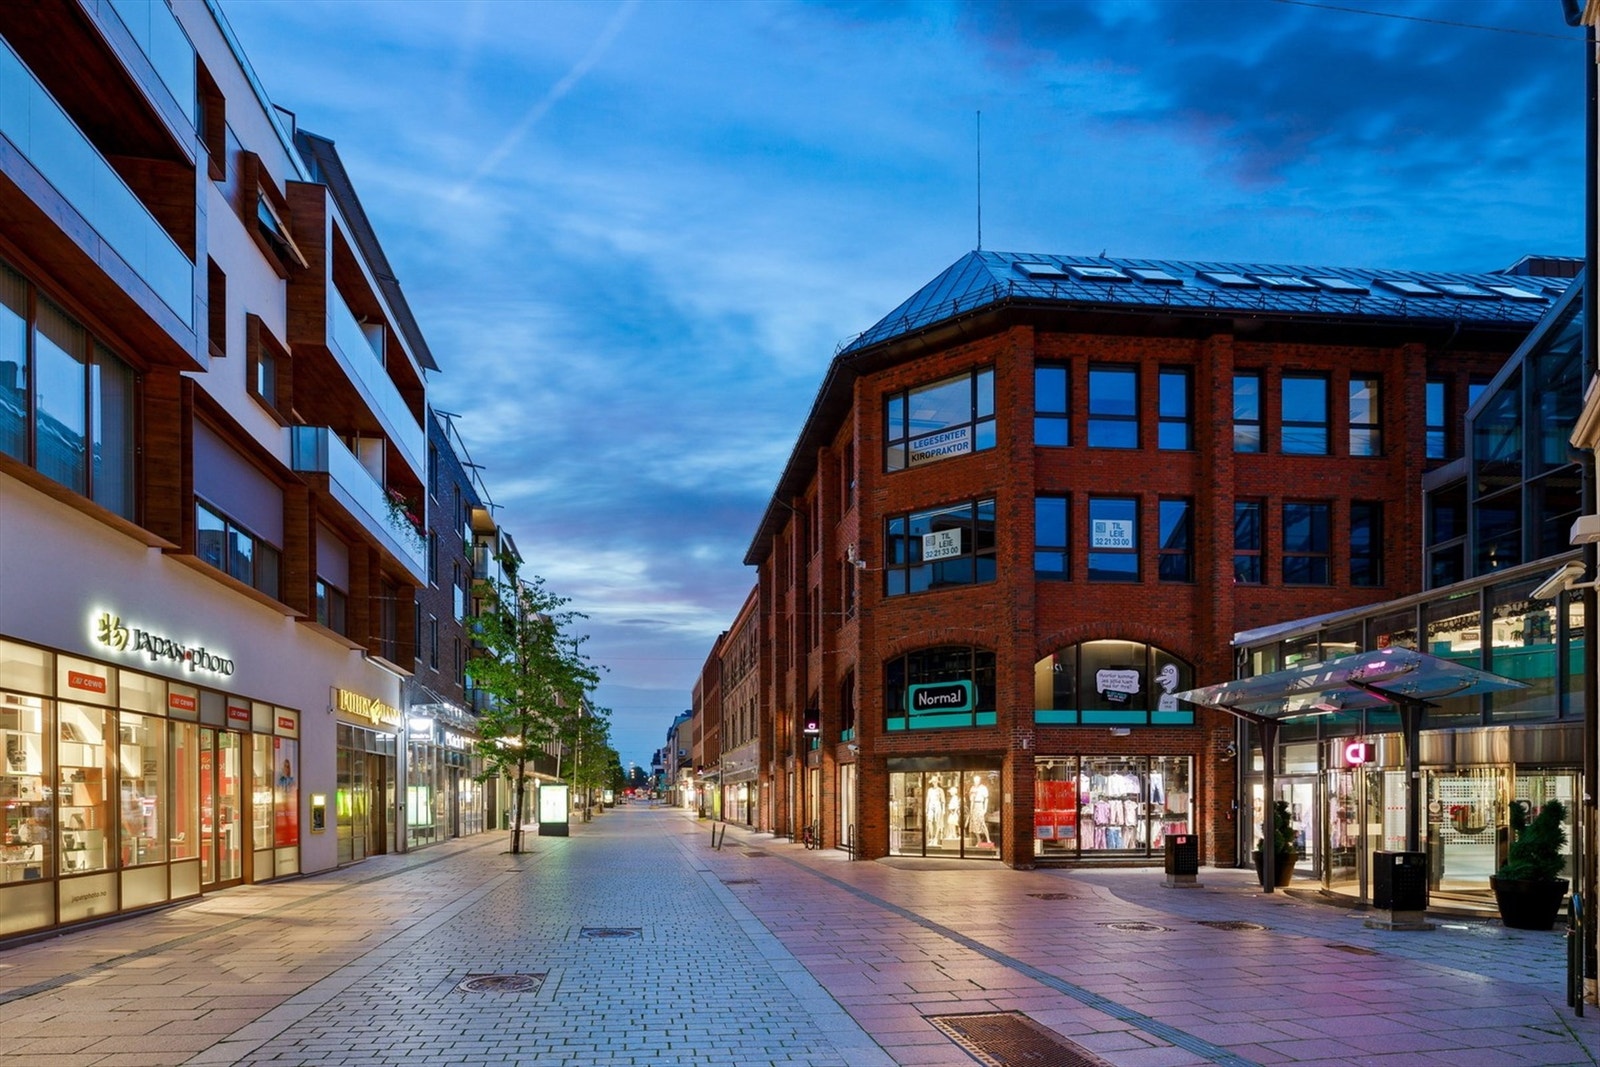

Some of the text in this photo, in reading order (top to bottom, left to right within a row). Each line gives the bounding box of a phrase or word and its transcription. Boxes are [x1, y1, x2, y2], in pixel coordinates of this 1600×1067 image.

[914, 429, 966, 449] LEGESENTER
[911, 441, 969, 462] KIROPRAKTOR
[1112, 522, 1122, 530] TIL
[1109, 530, 1125, 538] LEIE
[939, 539, 953, 548] LEIE
[1095, 537, 1129, 546] 32 21 33 00
[925, 546, 958, 558] 32 21 33 00
[83, 678, 103, 690] cewe
[918, 689, 962, 706] Normal
[180, 699, 194, 708] cewe
